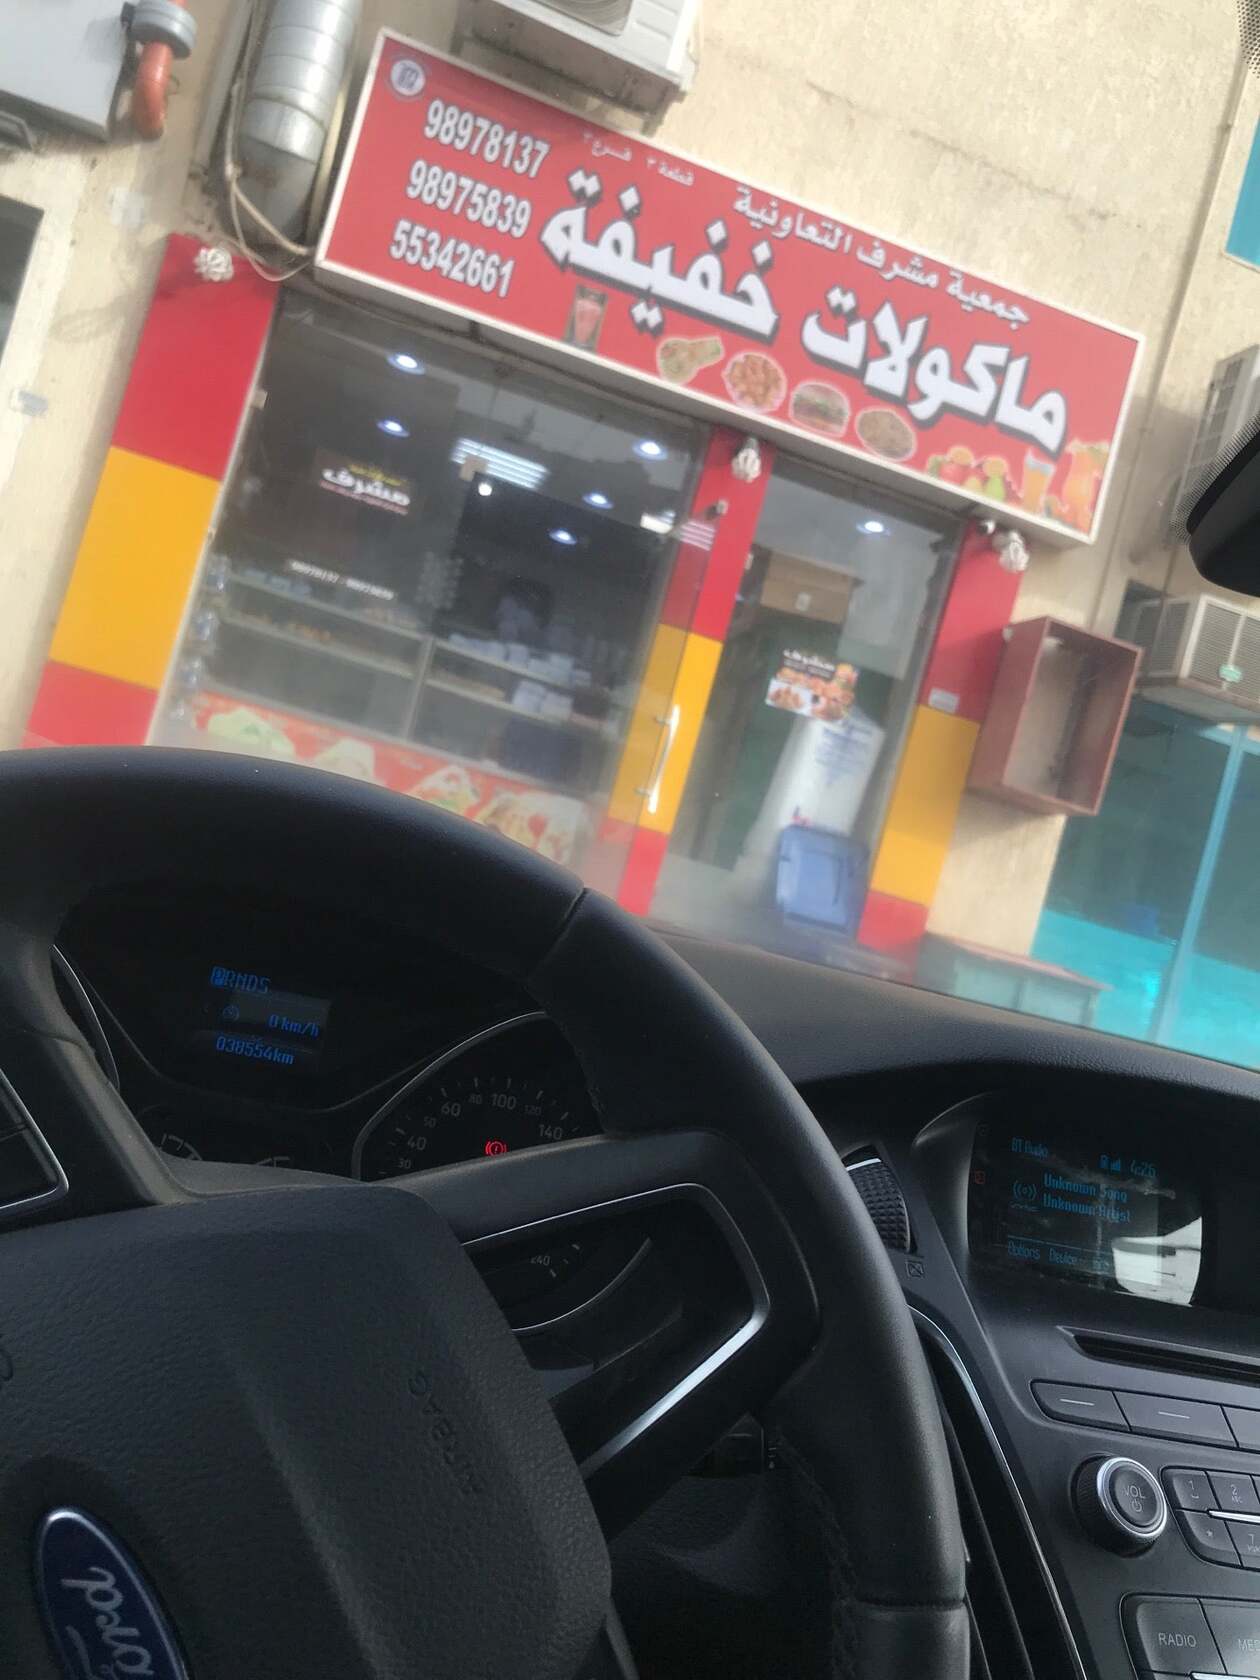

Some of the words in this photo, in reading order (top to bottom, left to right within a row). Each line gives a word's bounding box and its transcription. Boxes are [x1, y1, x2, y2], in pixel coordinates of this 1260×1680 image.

[424, 99, 549, 178] 98978137
[406, 160, 531, 239] 98975839
[733, 185, 853, 254] التعاونية
[389, 218, 514, 298] 55342661
[540, 168, 779, 346] خفيفة
[856, 240, 939, 289] مشرف
[946, 270, 1030, 330] جمعية
[801, 286, 1067, 457] ماكولات
[281, 1015, 319, 1037] km/h
[441, 1102, 462, 1118] 60
[491, 1093, 517, 1110] 100
[407, 1136, 427, 1150] 40
[538, 1123, 563, 1140] 140
[1043, 1173, 1096, 1196] Unknown
[1043, 1193, 1096, 1217] Unknown
[1123, 1485, 1146, 1500] VOL
[1158, 1632, 1197, 1648] RADIO
